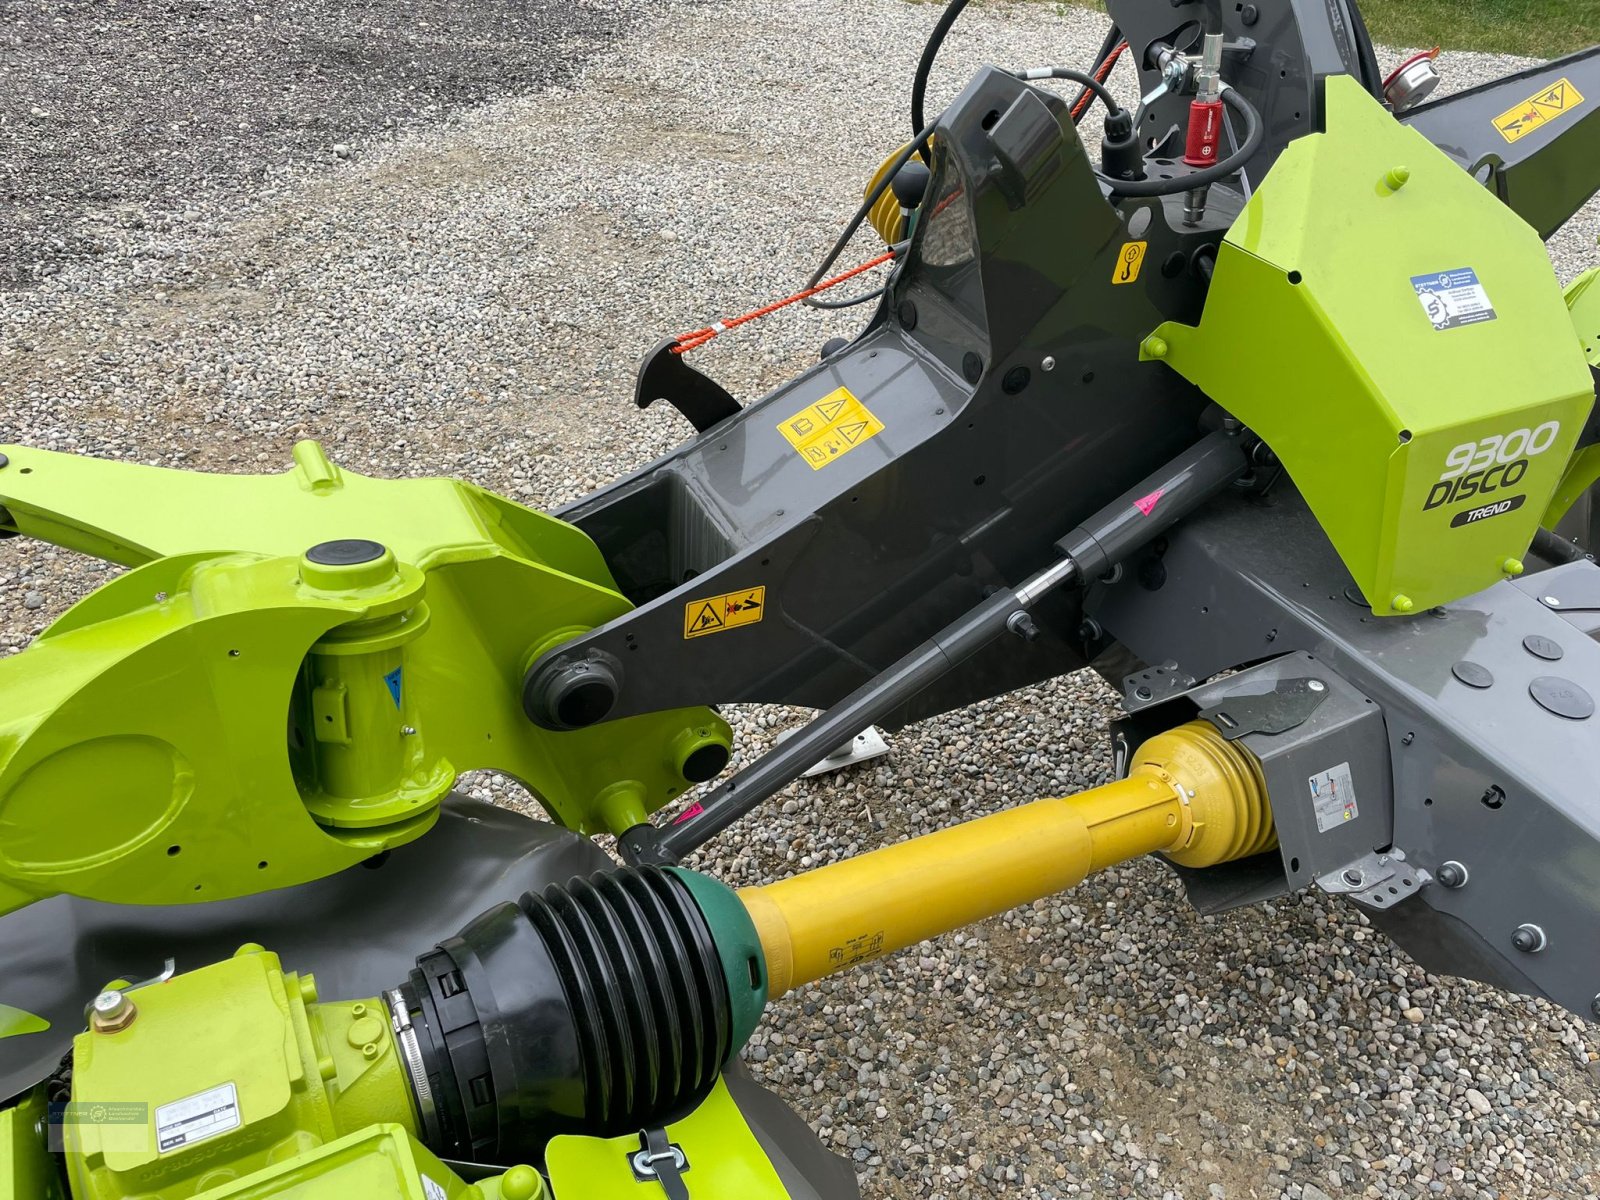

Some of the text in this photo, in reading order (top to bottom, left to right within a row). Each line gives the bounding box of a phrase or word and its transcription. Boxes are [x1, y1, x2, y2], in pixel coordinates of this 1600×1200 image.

[1440, 421, 1560, 481] 9300
[1423, 460, 1529, 511] DISCO
[1467, 500, 1512, 522] TREND
